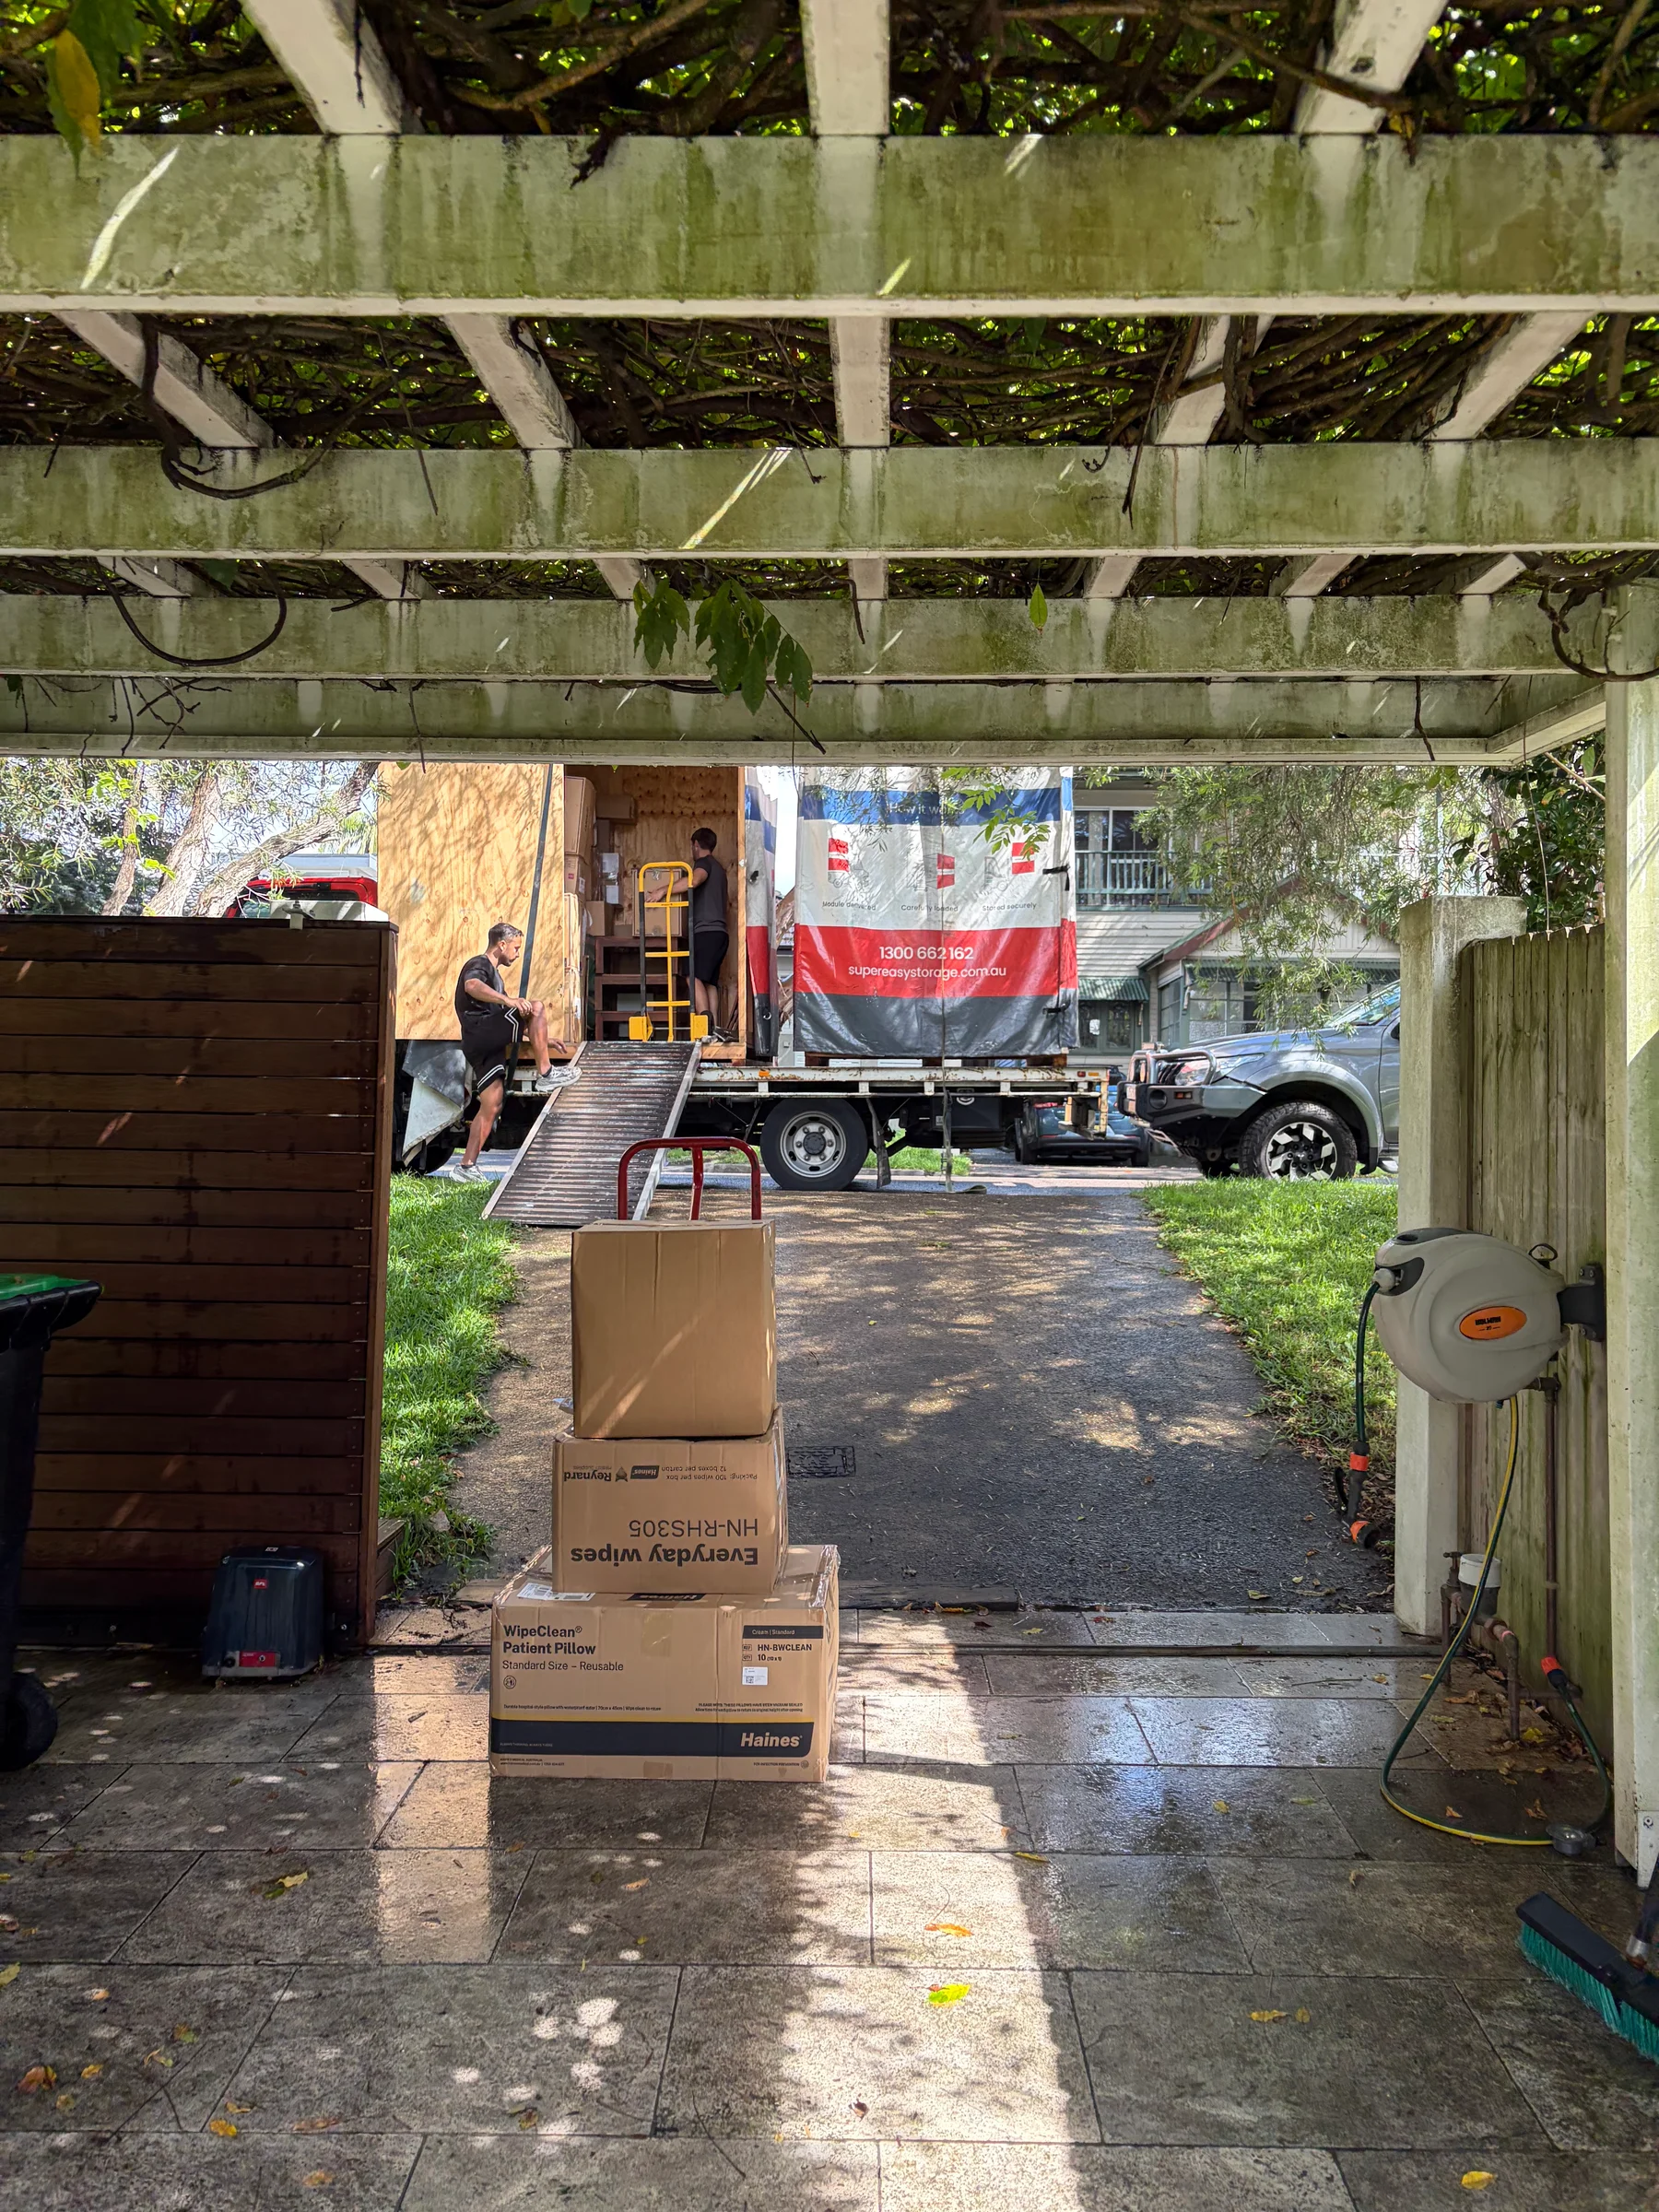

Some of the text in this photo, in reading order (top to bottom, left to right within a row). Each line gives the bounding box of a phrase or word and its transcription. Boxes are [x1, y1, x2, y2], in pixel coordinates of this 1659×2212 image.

[918, 803, 926, 814] it
[929, 805, 966, 815] wors
[879, 947, 974, 959] 1300 662 162
[848, 965, 1006, 981] supereasystorage.com.au
[564, 1470, 612, 1481] Reynard
[629, 1519, 759, 1537] HN-RHS305
[571, 1543, 759, 1567] Everyday wipes
[503, 1641, 596, 1654] Patient Pillow
[502, 1661, 546, 1670] Standard
[548, 1661, 569, 1670] Size
[580, 1662, 624, 1671] Reusable
[740, 1732, 800, 1747] Haines
